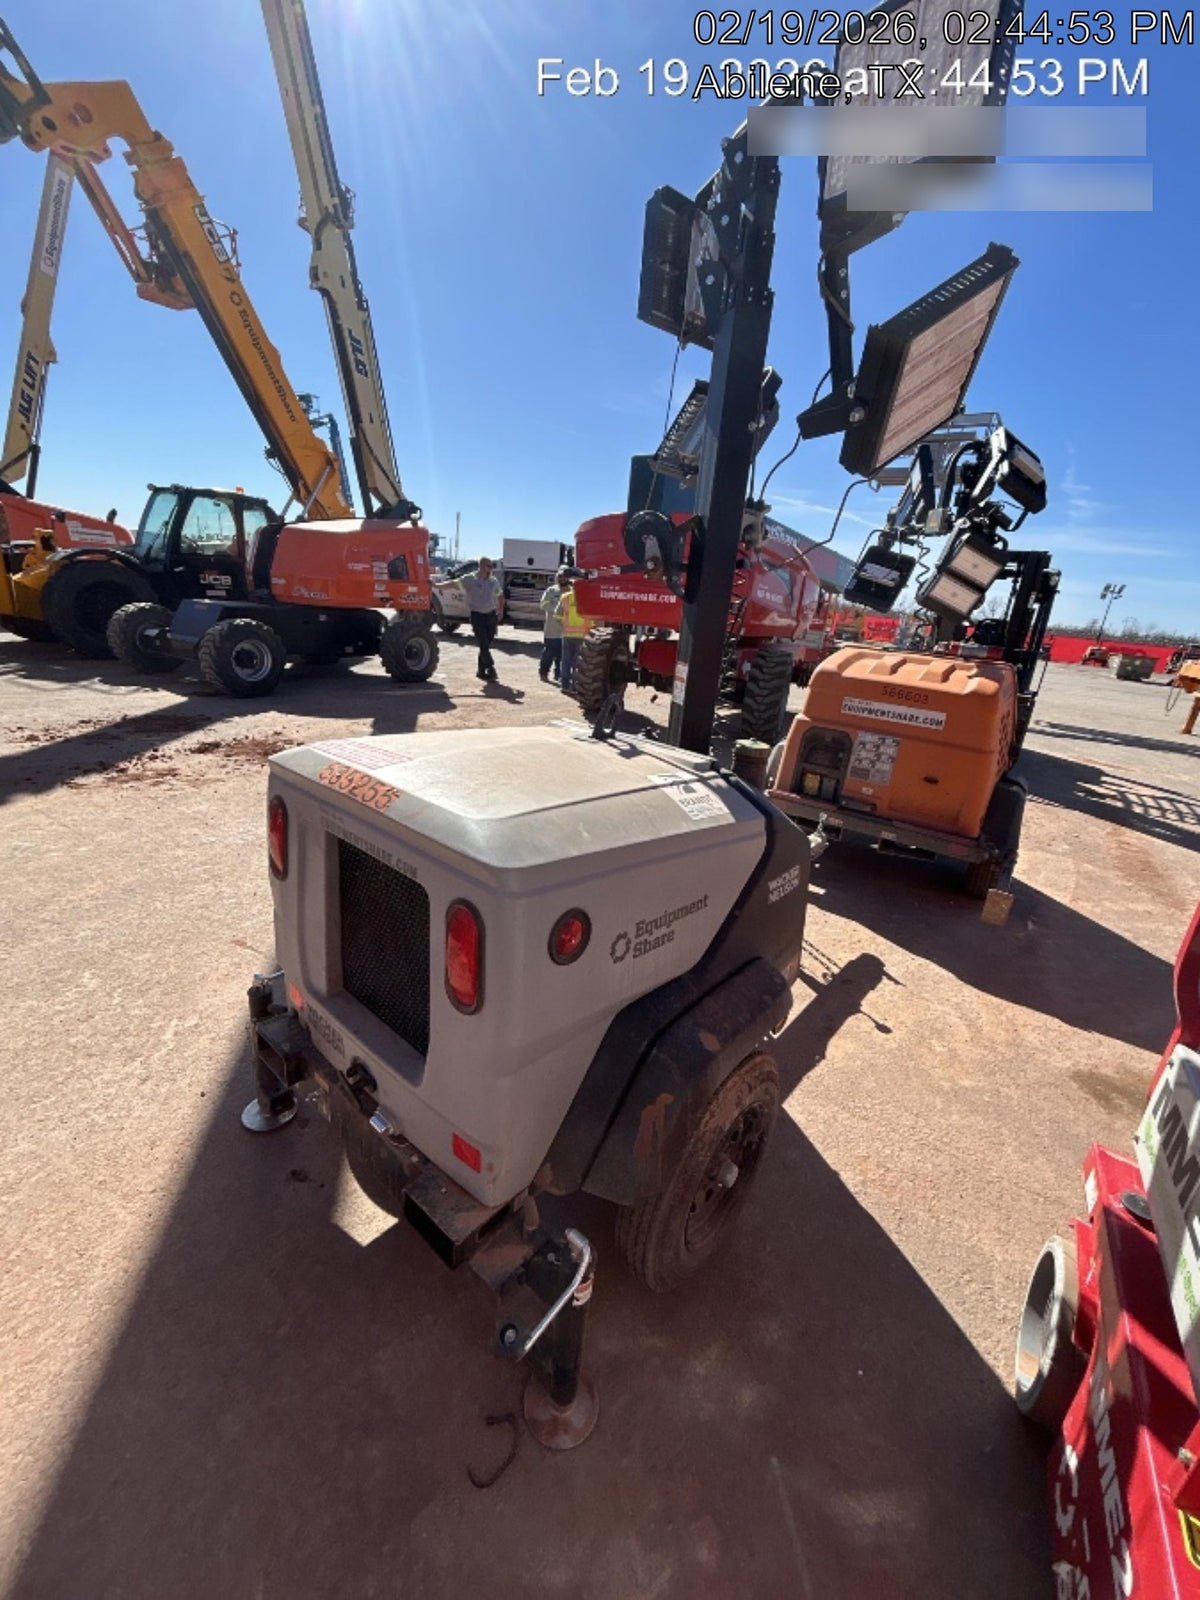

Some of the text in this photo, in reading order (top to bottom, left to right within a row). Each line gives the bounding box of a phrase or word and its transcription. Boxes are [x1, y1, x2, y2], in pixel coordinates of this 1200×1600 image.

[22, 350, 40, 392] LIFT
[200, 574, 232, 586] JCB
[635, 893, 710, 939] Equipment
[632, 929, 676, 959] Share
